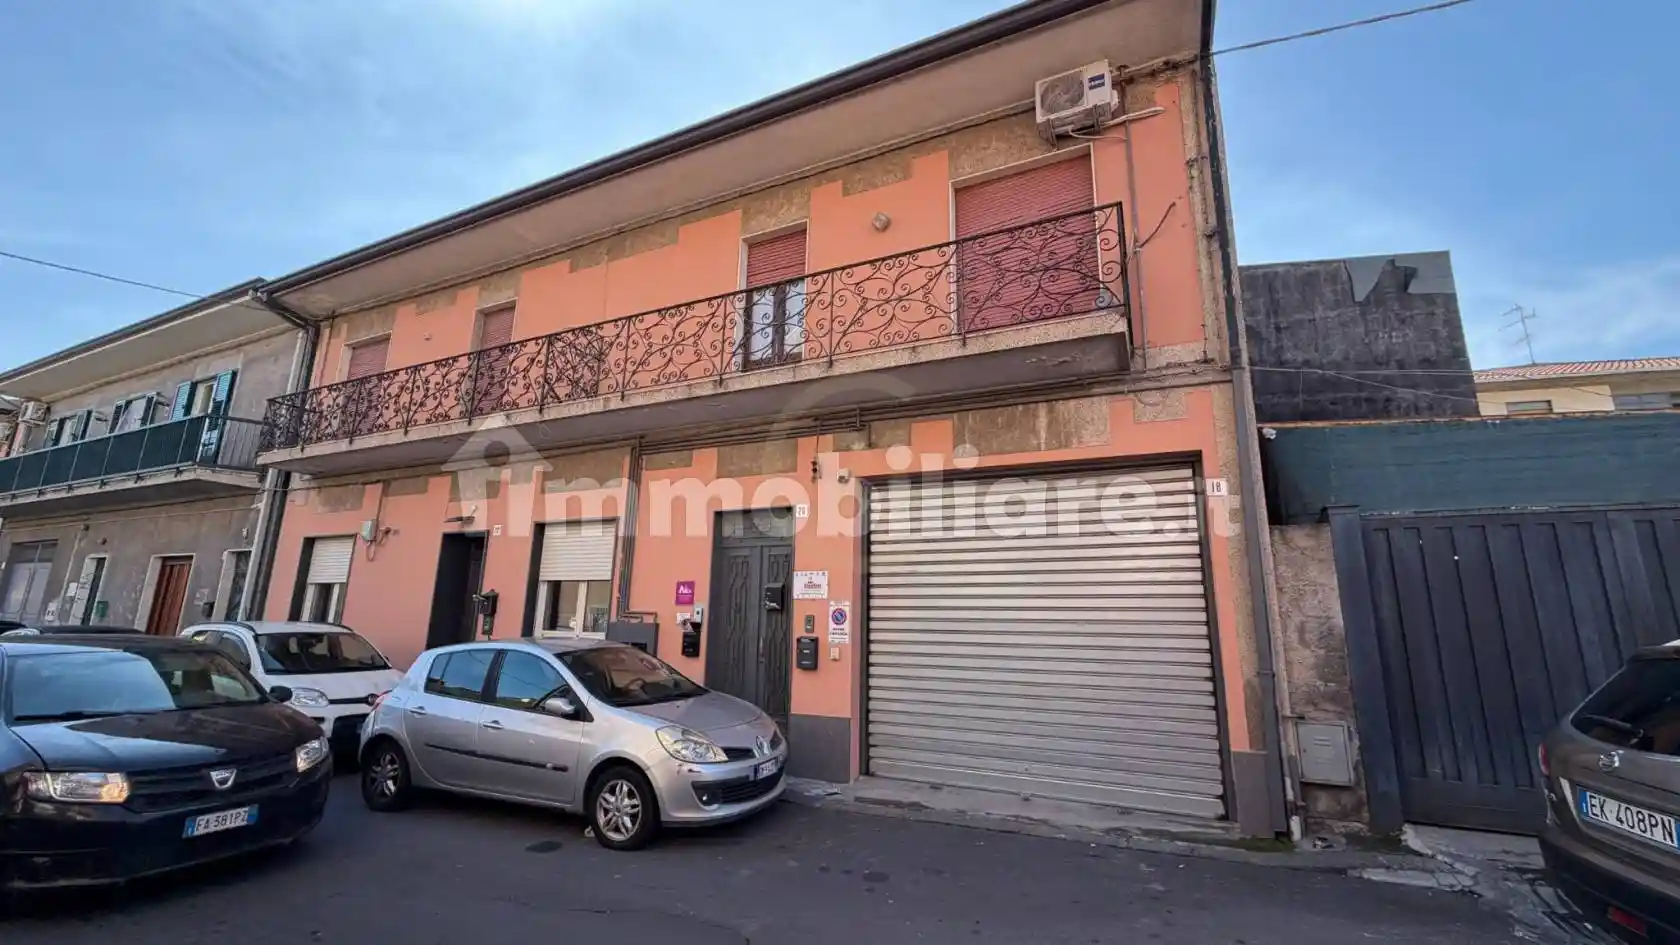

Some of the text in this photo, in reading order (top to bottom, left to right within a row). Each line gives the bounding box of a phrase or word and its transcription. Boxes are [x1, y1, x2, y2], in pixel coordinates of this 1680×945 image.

[1211, 481, 1222, 493] 18
[196, 817, 210, 831] FA
[1588, 794, 1609, 821] EK
[1615, 803, 1675, 844] 408PN
